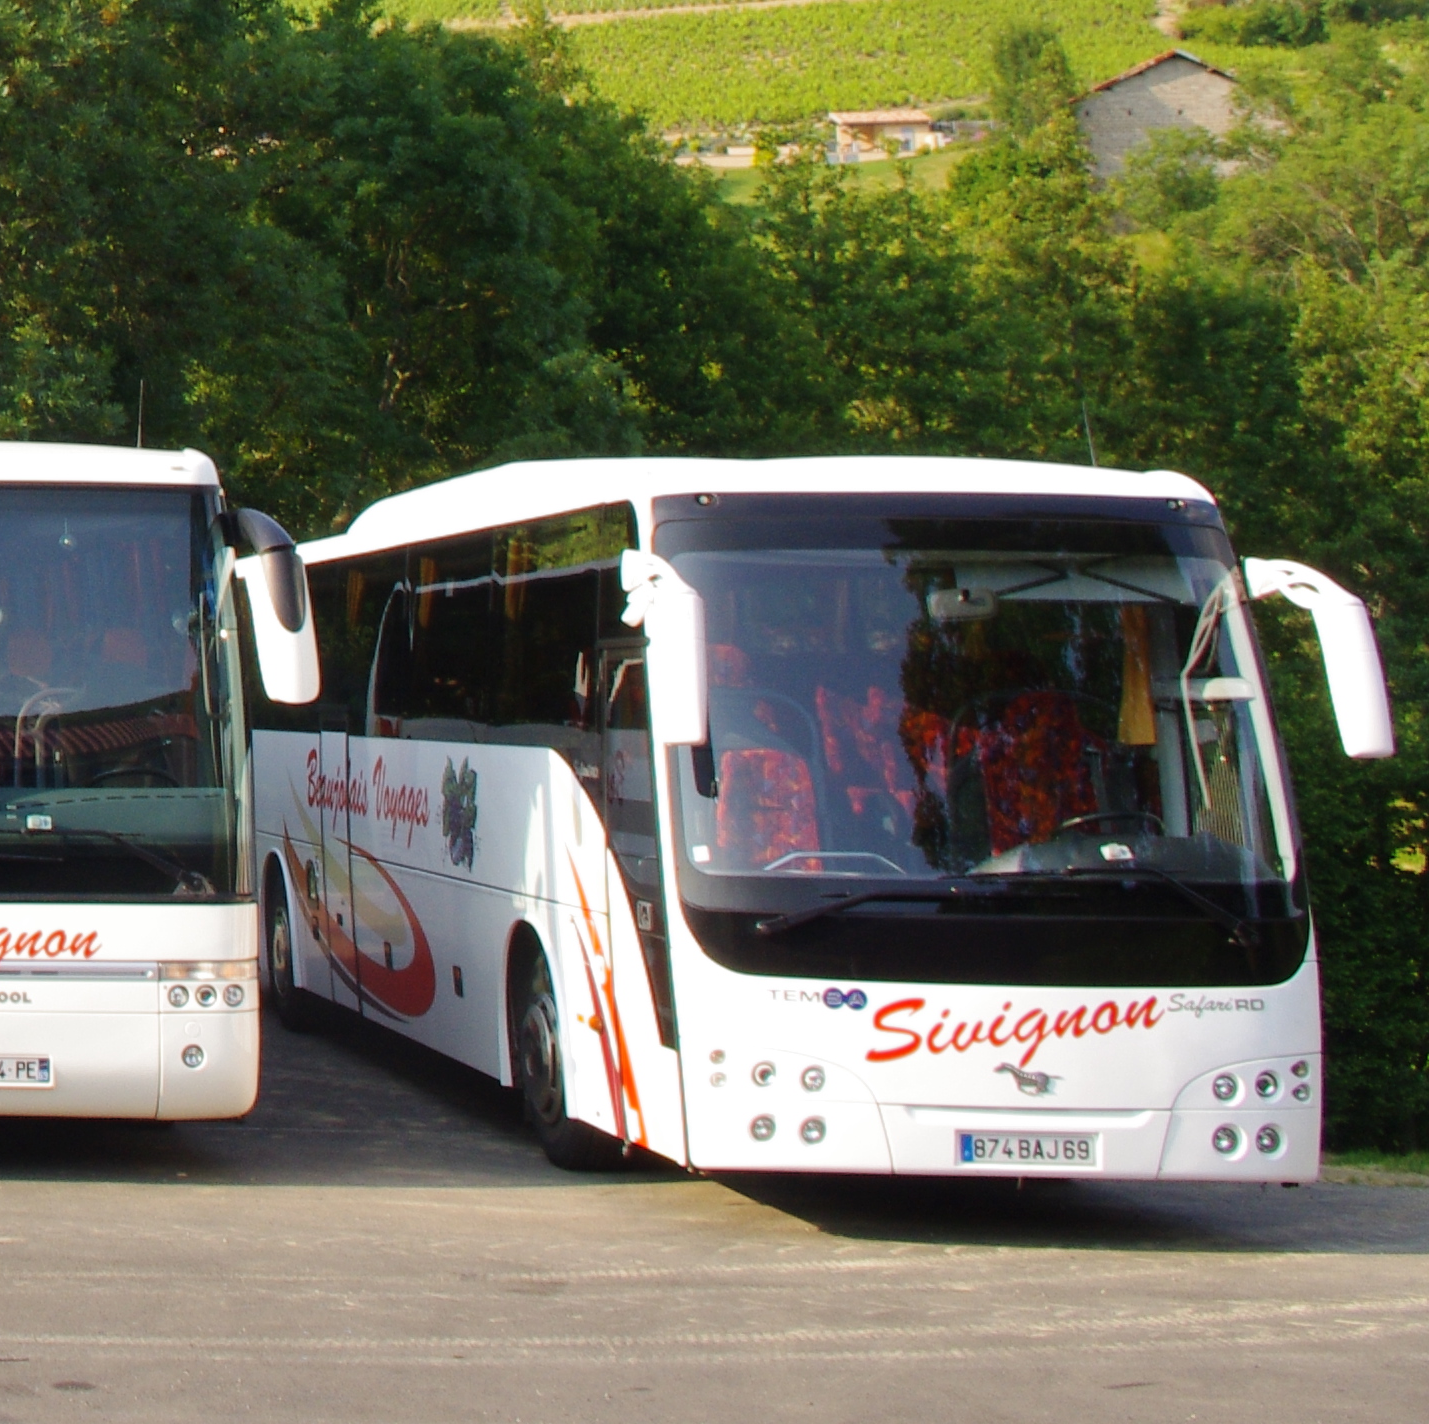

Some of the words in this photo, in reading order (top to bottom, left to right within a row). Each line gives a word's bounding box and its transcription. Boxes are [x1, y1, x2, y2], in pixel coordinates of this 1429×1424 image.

[372, 754, 430, 849] Voyages
[865, 996, 1166, 1068] Sivignon
[1167, 993, 1233, 1018] Safari
